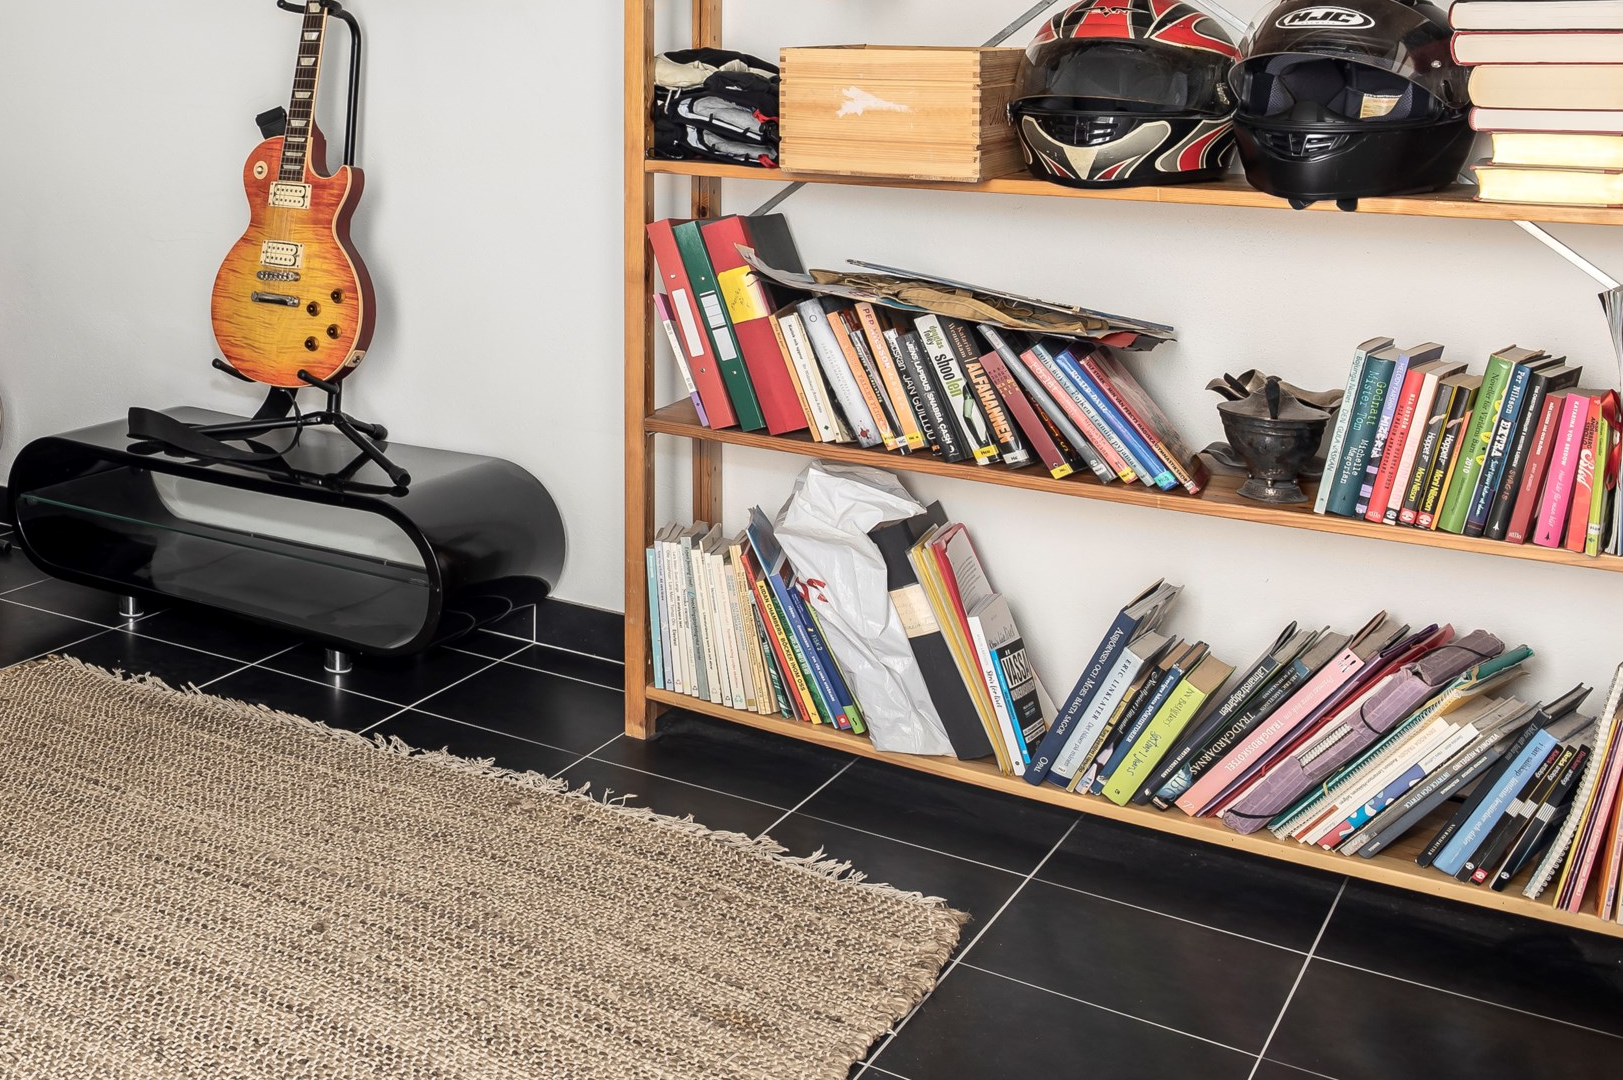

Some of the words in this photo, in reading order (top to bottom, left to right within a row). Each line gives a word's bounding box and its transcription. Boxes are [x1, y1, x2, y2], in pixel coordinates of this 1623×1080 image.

[1286, 10, 1354, 24] HJC
[862, 308, 874, 325] PER
[870, 328, 891, 368] NILSSON
[922, 329, 934, 346] foley
[929, 324, 944, 348] douglas
[946, 322, 968, 358] Wennstam
[956, 326, 974, 355] Katarina
[906, 340, 918, 360] JENS
[913, 360, 930, 391] LAPIDUS
[1030, 361, 1058, 392] Förlåt
[1349, 355, 1361, 381] Bojunga
[1393, 362, 1404, 385] MELODY
[1514, 370, 1525, 382] Per
[1343, 382, 1354, 403] Nunes
[1359, 370, 1378, 407] Mister
[1386, 386, 1397, 409] FARSHIN
[1484, 372, 1499, 400] Noveller
[965, 360, 1015, 444] ALFAHANNEN
[1366, 380, 1386, 425] Godnatt
[1482, 401, 1490, 409] för
[1505, 385, 1520, 414] Nilsson
[926, 392, 943, 422] SNABBA
[938, 423, 951, 444] CASH
[1090, 366, 1106, 384] STARK
[1107, 386, 1116, 397] MIN
[1114, 395, 1124, 407] VÄN
[1123, 406, 1138, 423] PERCYS
[1136, 422, 1155, 444] MAGISKA
[1153, 443, 1186, 483] GYMNASTIKSKOR
[1338, 408, 1348, 423] DEN
[1353, 411, 1367, 431] Tom
[1473, 410, 1488, 438] Världens
[1569, 401, 1579, 427] KATARINA
[1333, 425, 1343, 443] GULA
[1371, 415, 1390, 459] MIZERIA
[1420, 431, 1435, 454] Hoppet
[1438, 433, 1453, 458] Hoppet
[1469, 438, 1478, 453] Barn
[1491, 419, 1510, 458] EXTRA
[1326, 444, 1339, 471] VÄSKAN
[1338, 446, 1356, 484] Magorian
[1351, 438, 1368, 475] Michelle
[1462, 456, 1472, 473] 2010
[1560, 443, 1569, 465] BREDOW
[1414, 467, 1424, 482] Moni
[1432, 469, 1443, 486] Moni
[1575, 449, 1595, 491] Blod
[1408, 482, 1420, 501] Nilsson
[1424, 486, 1438, 511] Nilsson
[759, 584, 770, 602] AIDAN
[766, 603, 783, 635] CHAMBERS
[779, 637, 793, 661] BÖCKER
[789, 661, 799, 678] INOM
[795, 678, 805, 691] OSS
[796, 651, 805, 662] MED
[1117, 659, 1133, 678] ERIC
[1158, 675, 1174, 693] Sveriges
[1217, 665, 1269, 717] Latmansträdgården
[1089, 679, 1120, 720] LINKLATER
[1150, 691, 1162, 705] bästa
[1085, 721, 1094, 731] Det
[1125, 704, 1154, 743] SPÖKHISTORIER
[1522, 722, 1537, 739] Dikter
[1076, 729, 1089, 744] blåser
[1188, 710, 1255, 775] TRÄDGÅRDARNAS
[1224, 717, 1284, 773] TRÄDGÅRDSSKÖTSEL
[1473, 728, 1499, 752] VERONICA
[1516, 736, 1527, 746] att
[1062, 750, 1076, 766] månen
[1450, 747, 1476, 771] HEJDELIND
[1504, 751, 1515, 762] om
[1510, 742, 1522, 755] tala
[1557, 750, 1571, 766] Skräck
[1430, 769, 1450, 788] INTRYCK
[1546, 764, 1561, 781] antologi
[1162, 773, 1190, 800] ABC
[1422, 784, 1433, 795] OCH
[1404, 791, 1425, 811] UTRYCK
